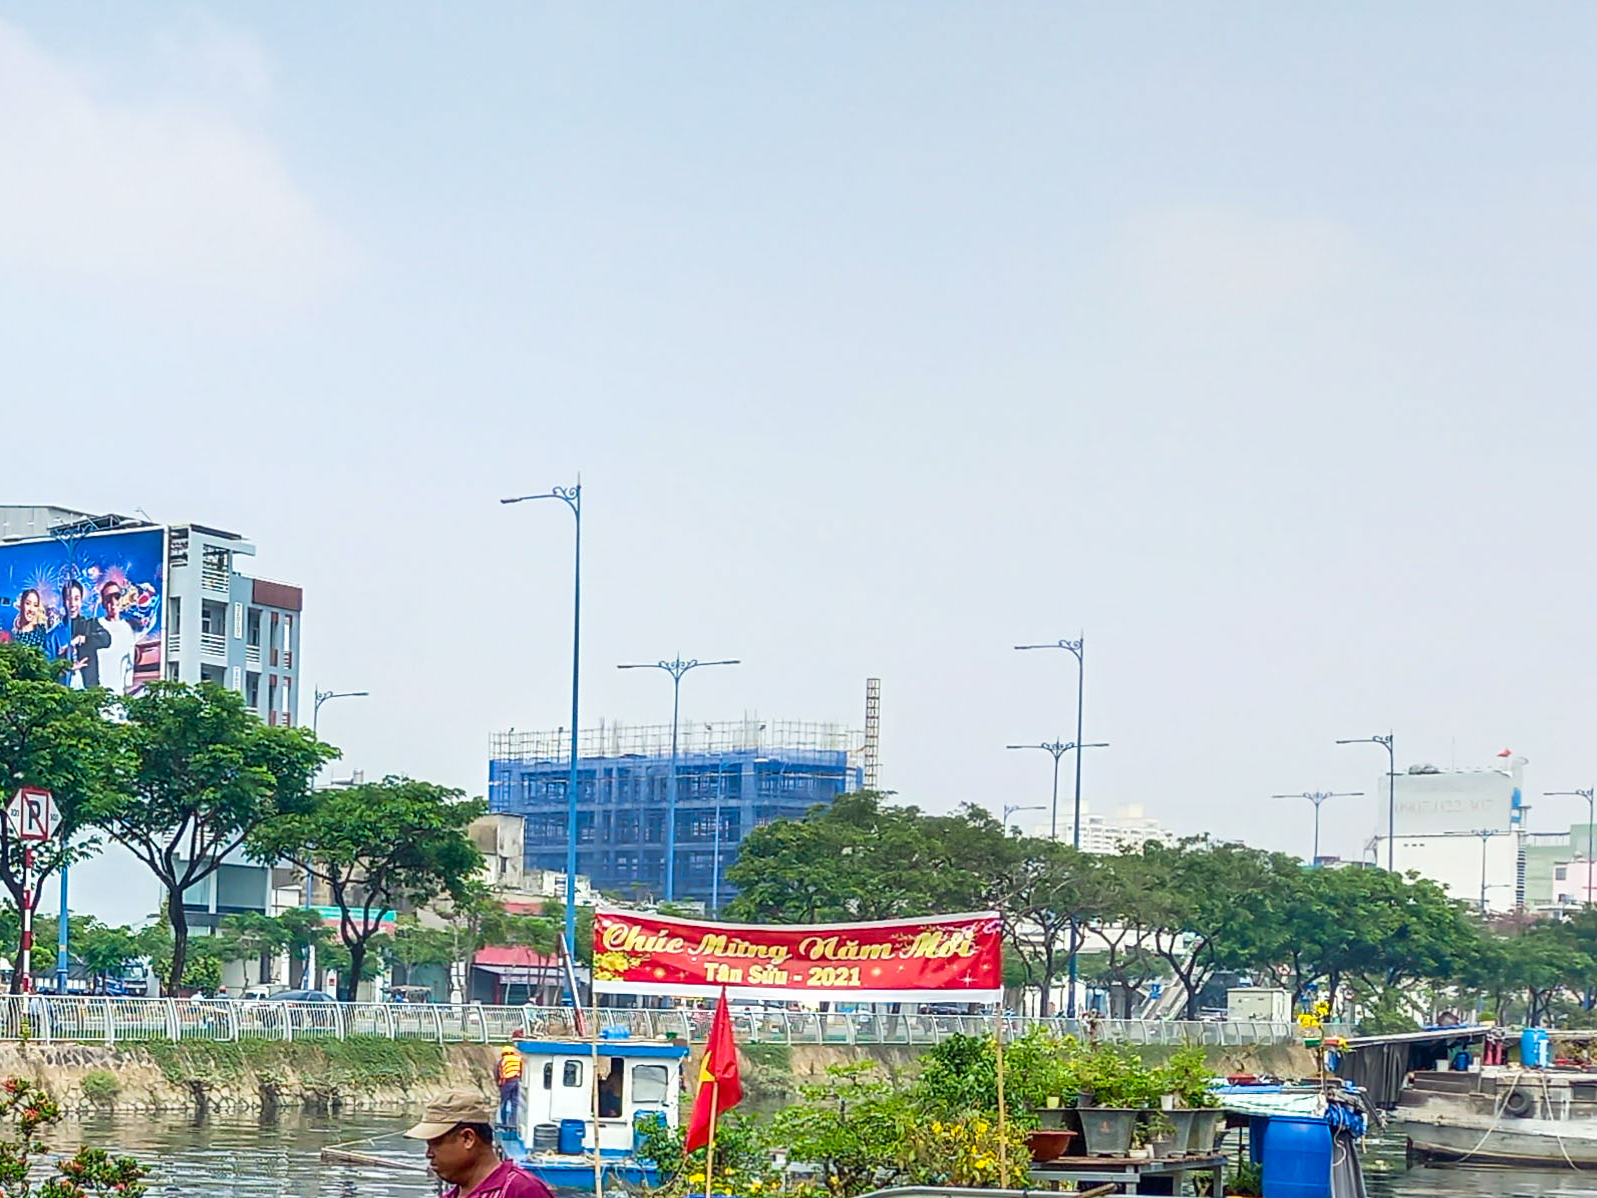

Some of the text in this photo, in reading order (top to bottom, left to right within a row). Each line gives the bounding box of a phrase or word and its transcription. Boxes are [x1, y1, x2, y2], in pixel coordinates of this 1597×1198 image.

[28, 799, 41, 830] P
[602, 922, 980, 965] Chúc Mừng Năm Mới
[704, 962, 743, 984] Tân
[748, 963, 789, 986] Sửu
[806, 966, 862, 987] 2021
